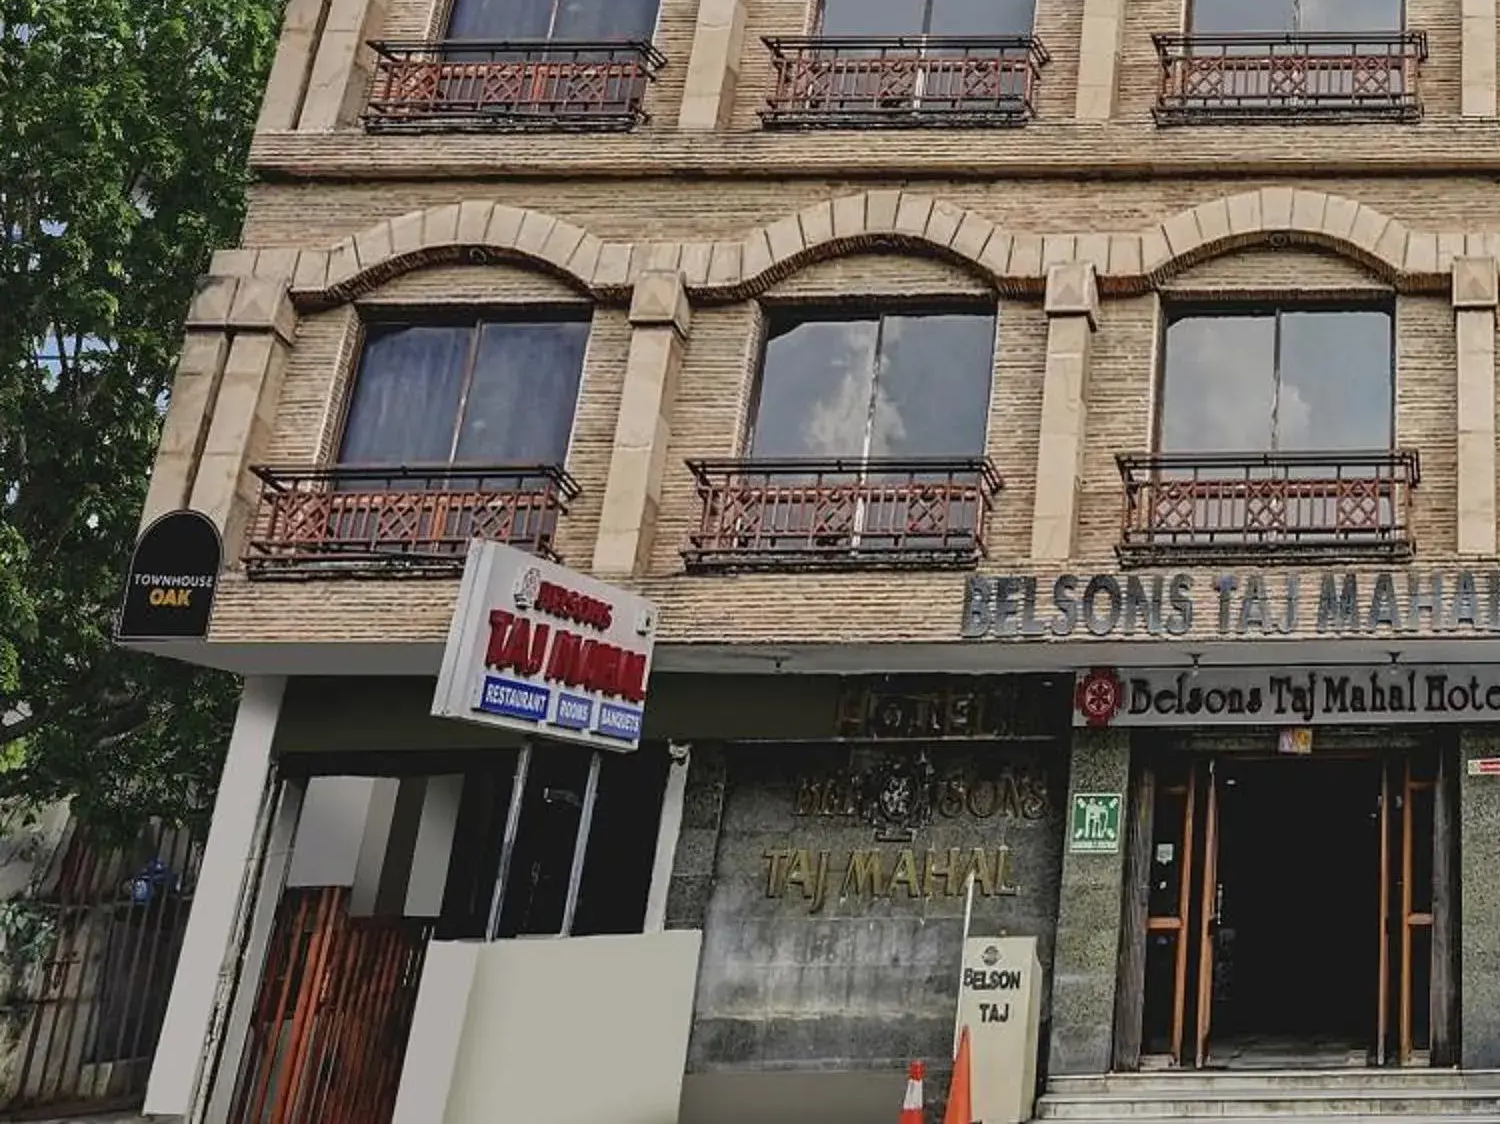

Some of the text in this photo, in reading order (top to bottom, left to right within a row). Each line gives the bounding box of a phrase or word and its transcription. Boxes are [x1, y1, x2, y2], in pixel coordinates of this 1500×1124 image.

[134, 573, 214, 587] TOWNHOUSE
[149, 587, 192, 606] OAK
[961, 573, 1193, 638] BELSONS
[1213, 573, 1299, 635] TAJ
[485, 609, 550, 679] TAJ
[485, 684, 547, 713] RESTAURANT
[1128, 669, 1263, 715] Belsons
[1270, 672, 1316, 721] Taj
[1323, 669, 1417, 714] Mahal
[762, 846, 1018, 914] TAJ MAHAL
[963, 967, 1021, 990] BELSON
[979, 1003, 1009, 1023] TAJ
